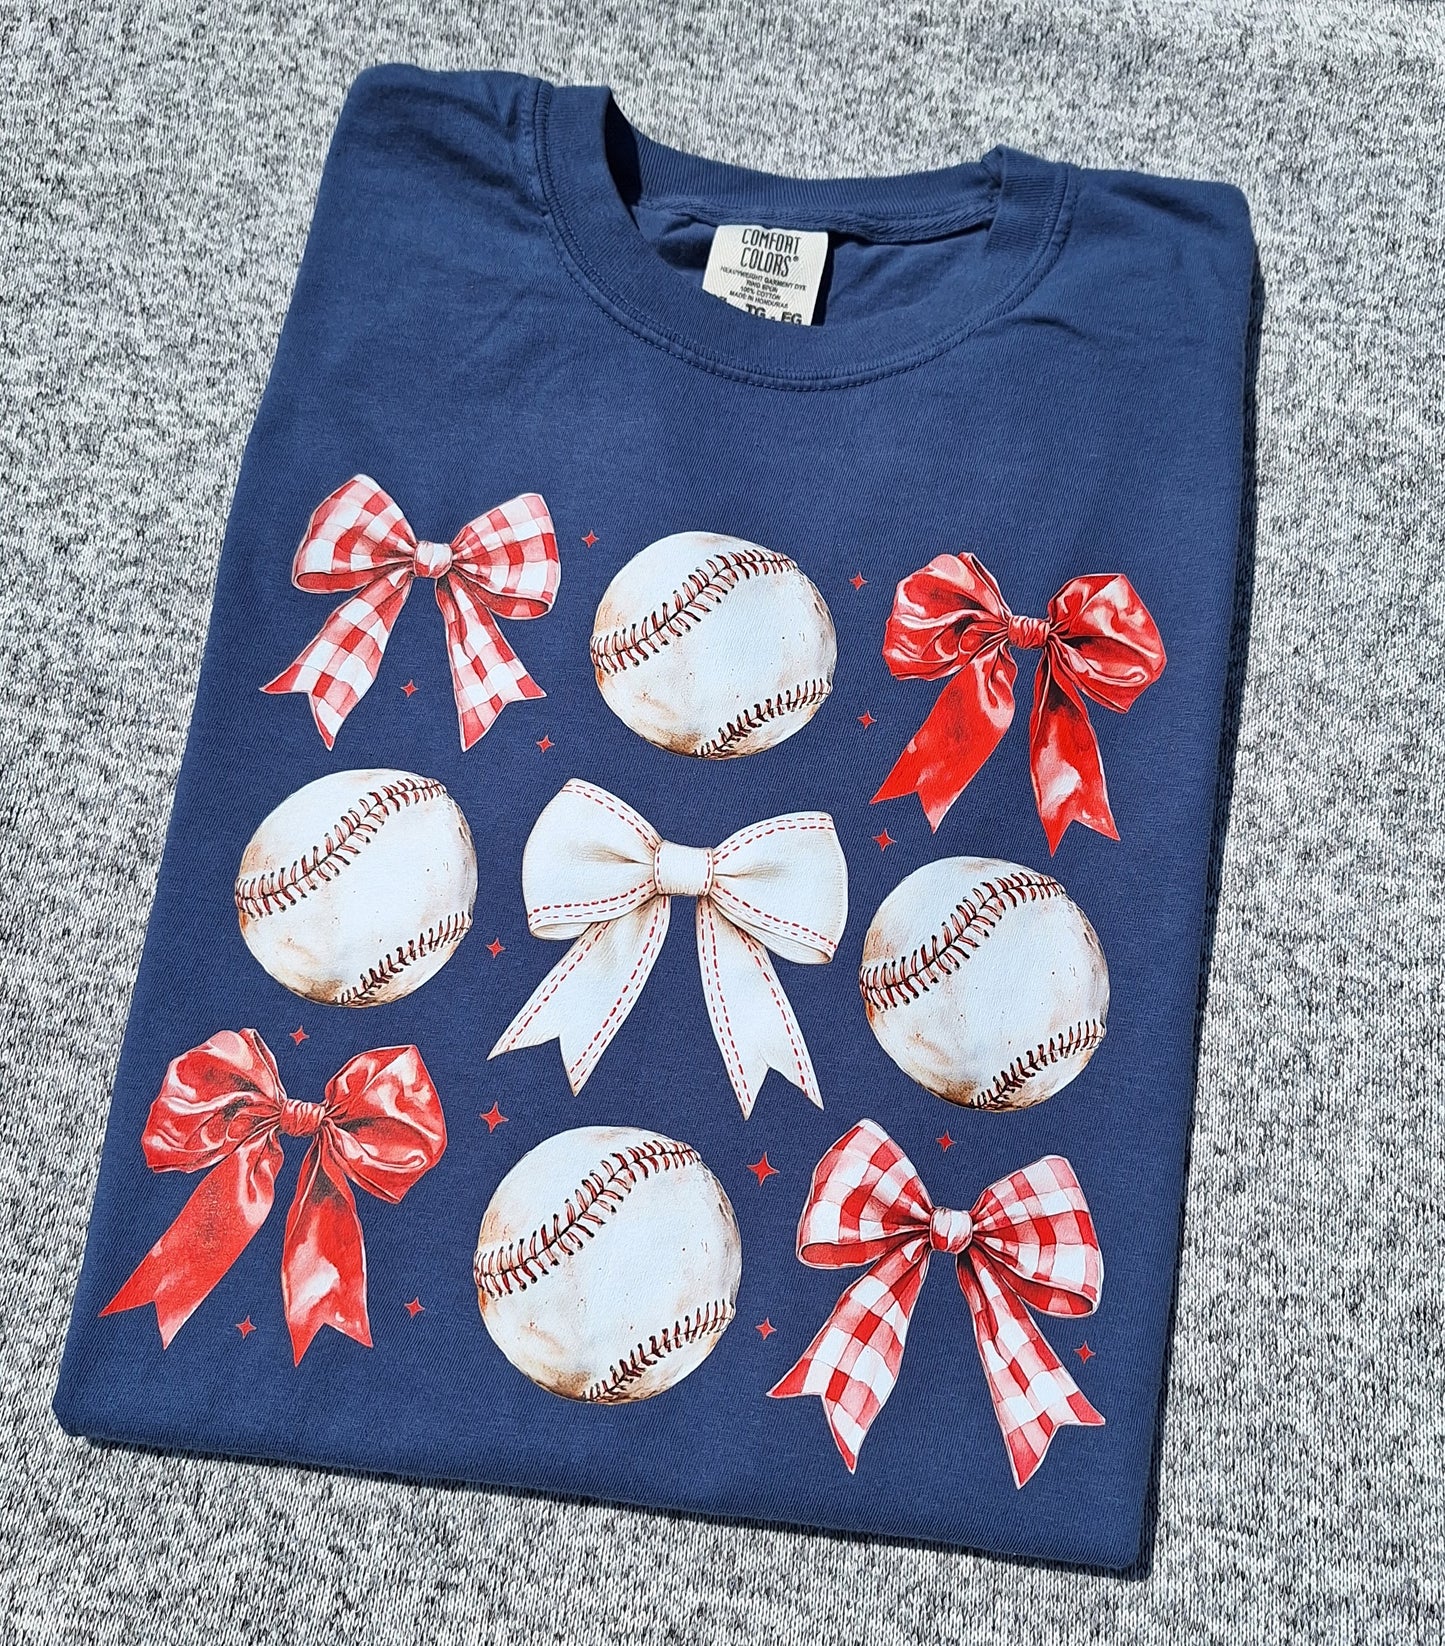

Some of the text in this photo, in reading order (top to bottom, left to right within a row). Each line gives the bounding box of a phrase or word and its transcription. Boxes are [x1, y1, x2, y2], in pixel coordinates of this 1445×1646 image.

[741, 228, 801, 254] COMFORT
[720, 266, 807, 291] HEAVYWEIGHT GARMENT DYE
[746, 280, 778, 293] RING SPUN
[729, 290, 747, 298] MADE
[754, 297, 788, 308] HONDURAS
[741, 286, 781, 300] 100% COTTON
